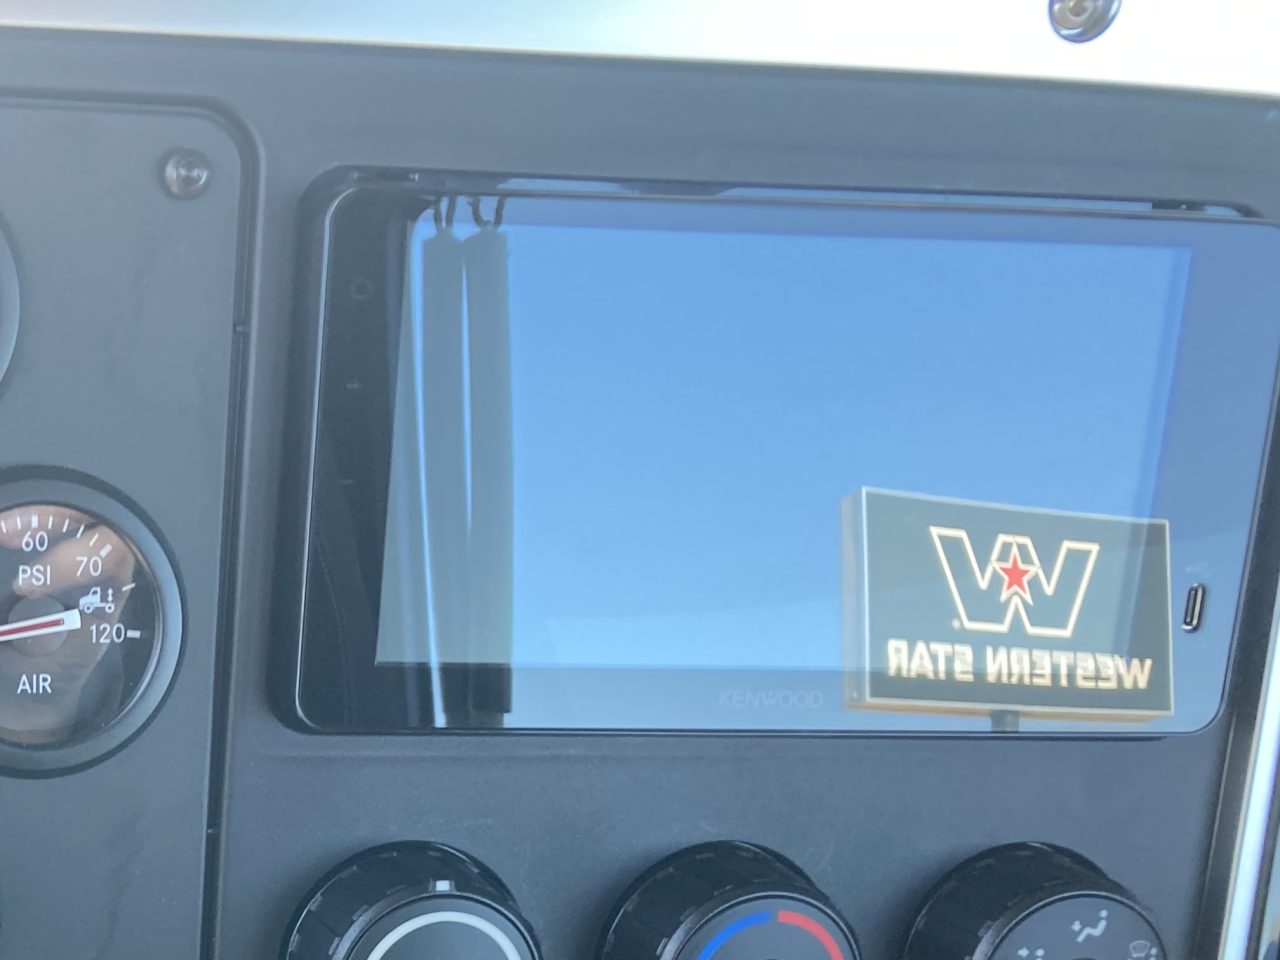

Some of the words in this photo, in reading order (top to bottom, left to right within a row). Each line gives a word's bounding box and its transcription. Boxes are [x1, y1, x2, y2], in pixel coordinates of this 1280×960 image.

[21, 531, 48, 552] 60
[18, 564, 51, 586] PSI
[75, 556, 102, 578] 70
[90, 623, 125, 645] 120
[16, 673, 52, 695] AIR
[719, 689, 823, 709] KENWOOD
